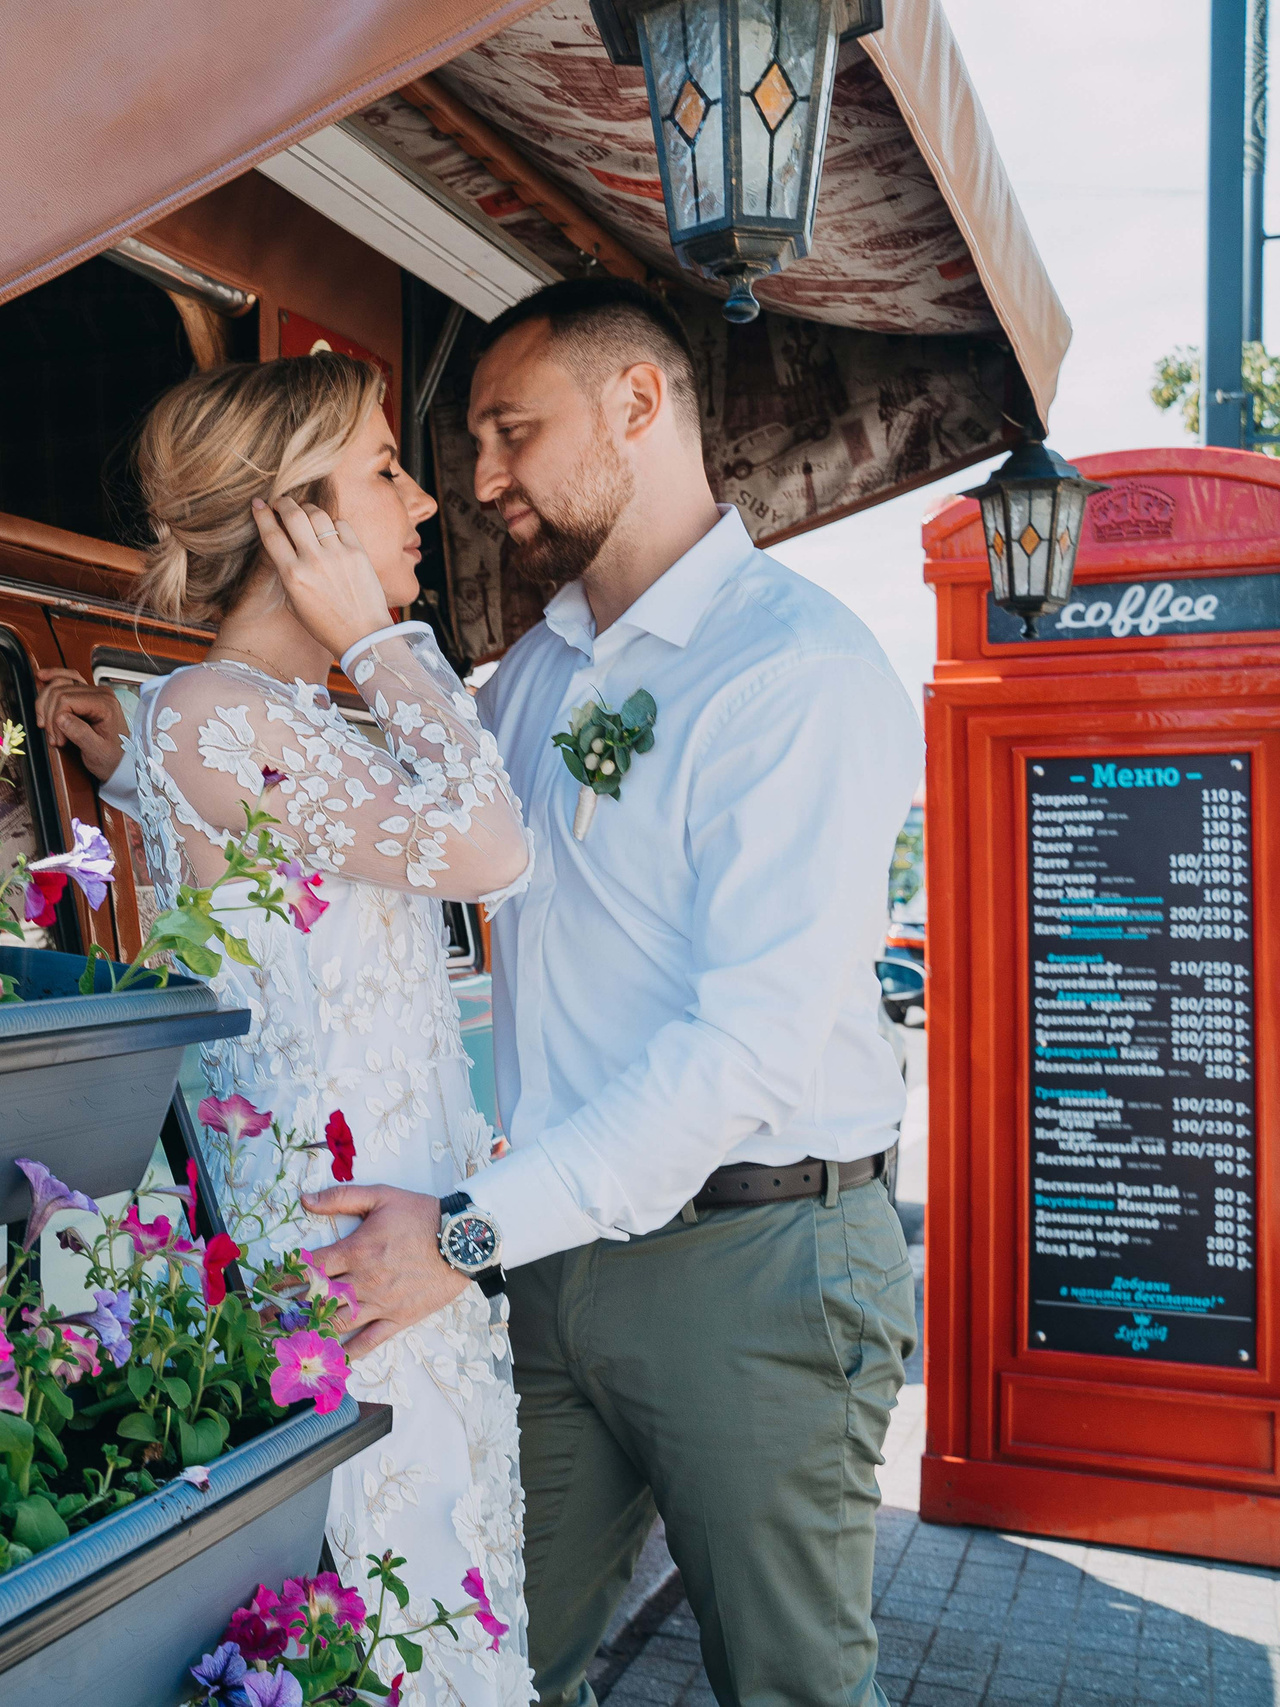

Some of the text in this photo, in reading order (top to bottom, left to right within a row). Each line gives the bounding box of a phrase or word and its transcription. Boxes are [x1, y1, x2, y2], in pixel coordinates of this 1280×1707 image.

[1055, 583, 1219, 638] coffee
[1091, 763, 1181, 788] Меню
[1095, 1229, 1130, 1246] кофе
